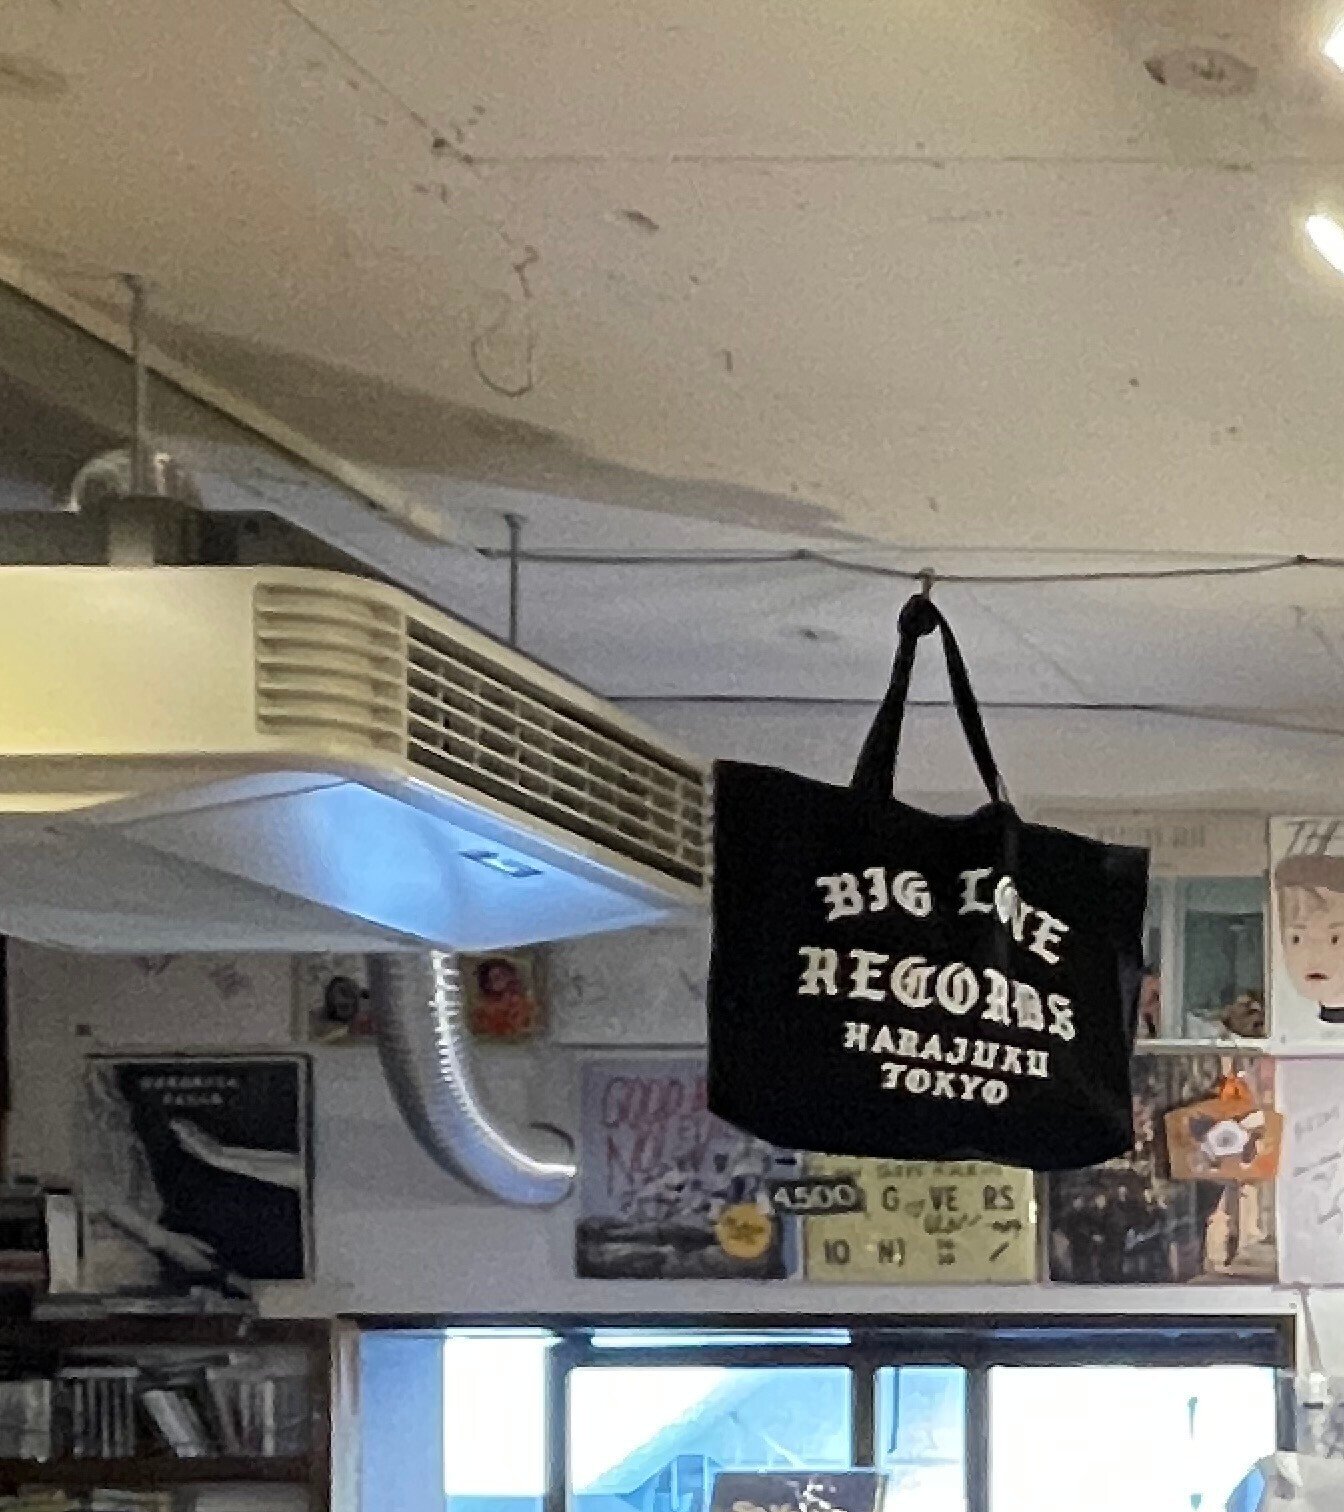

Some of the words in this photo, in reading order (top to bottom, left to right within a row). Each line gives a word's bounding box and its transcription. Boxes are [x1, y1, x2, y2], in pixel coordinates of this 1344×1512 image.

[1286, 820, 1340, 855] THE
[815, 866, 933, 923] BIG
[797, 946, 1076, 1042] RECORDS
[842, 1020, 1050, 1078] HARAJUKU
[880, 1062, 1009, 1106] TOKYO
